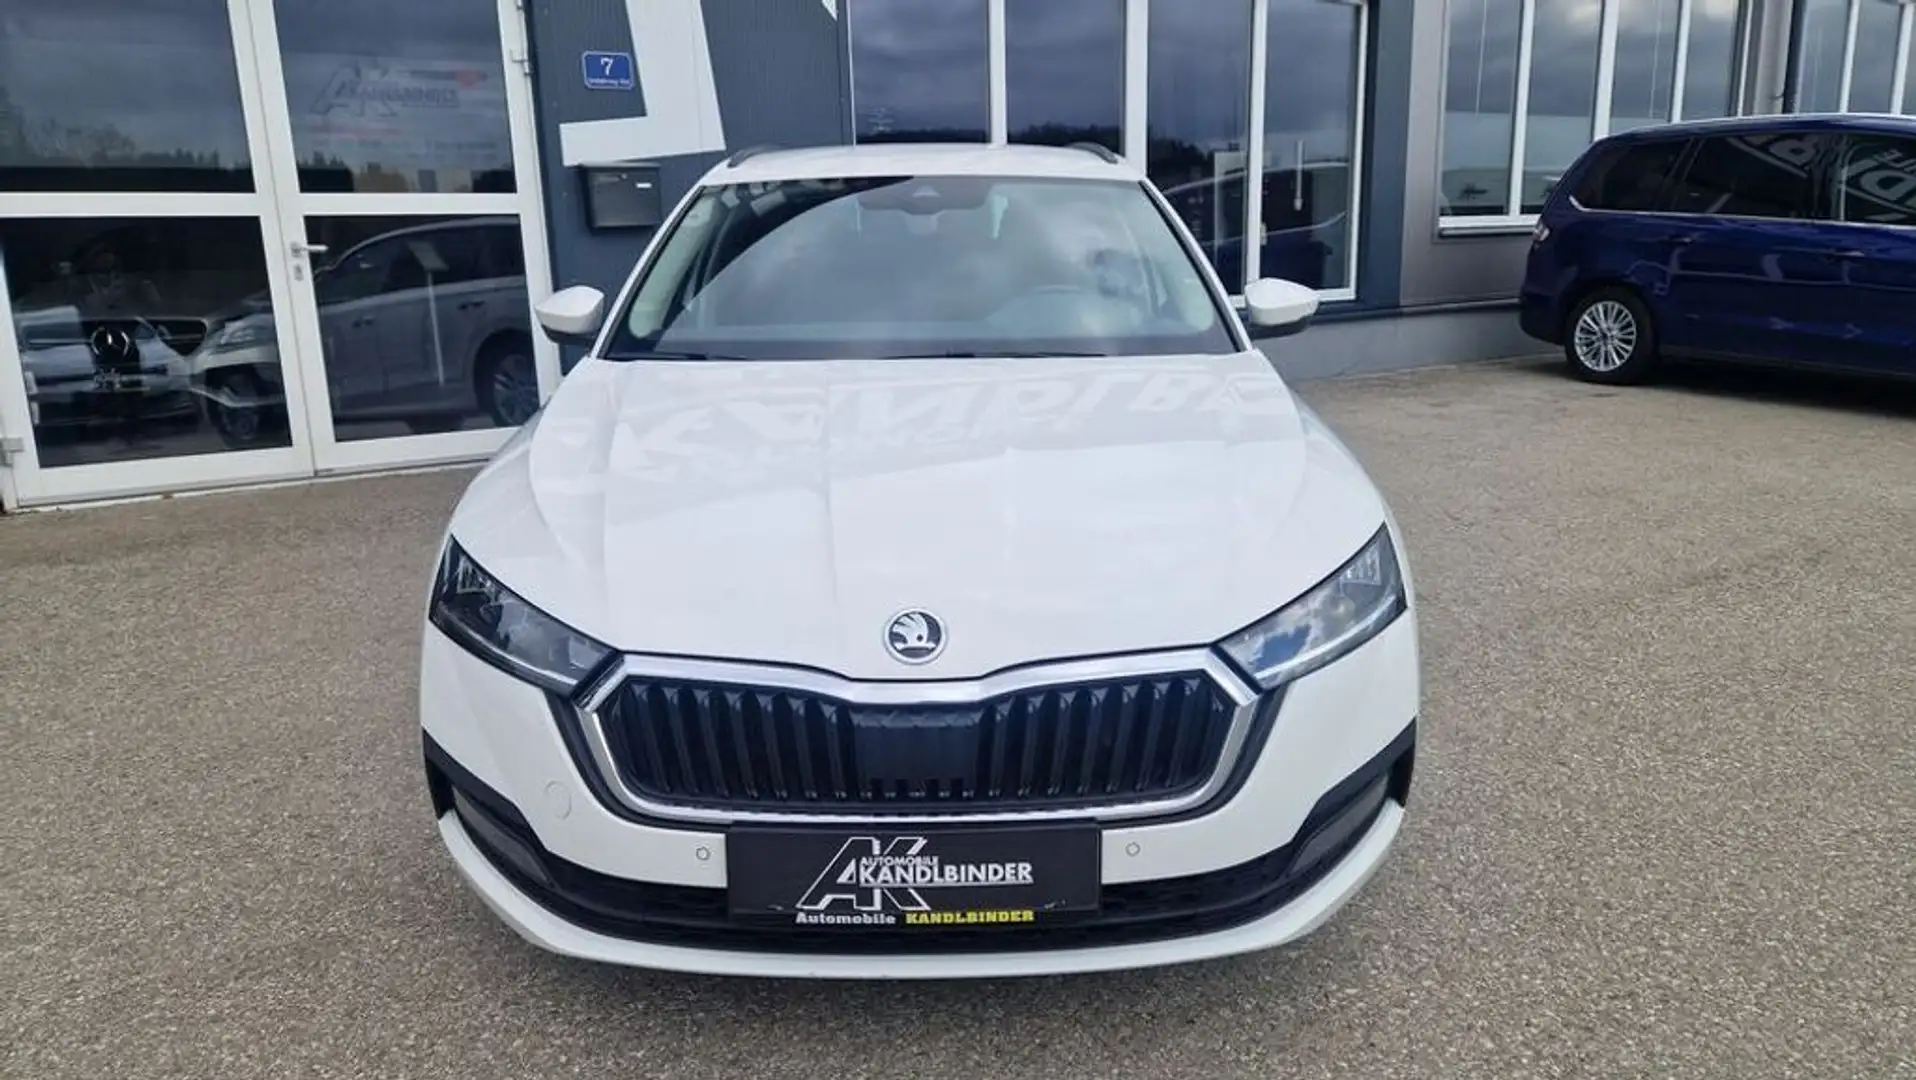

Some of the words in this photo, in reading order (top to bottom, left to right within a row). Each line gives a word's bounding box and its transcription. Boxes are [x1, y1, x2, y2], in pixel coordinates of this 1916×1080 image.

[600, 57, 614, 76] 7
[860, 856, 939, 866] AUTOMOBILE
[859, 863, 1034, 885] KANDLBINDER
[796, 913, 896, 925] Automobile
[905, 911, 1034, 924] KANDLBINDER
